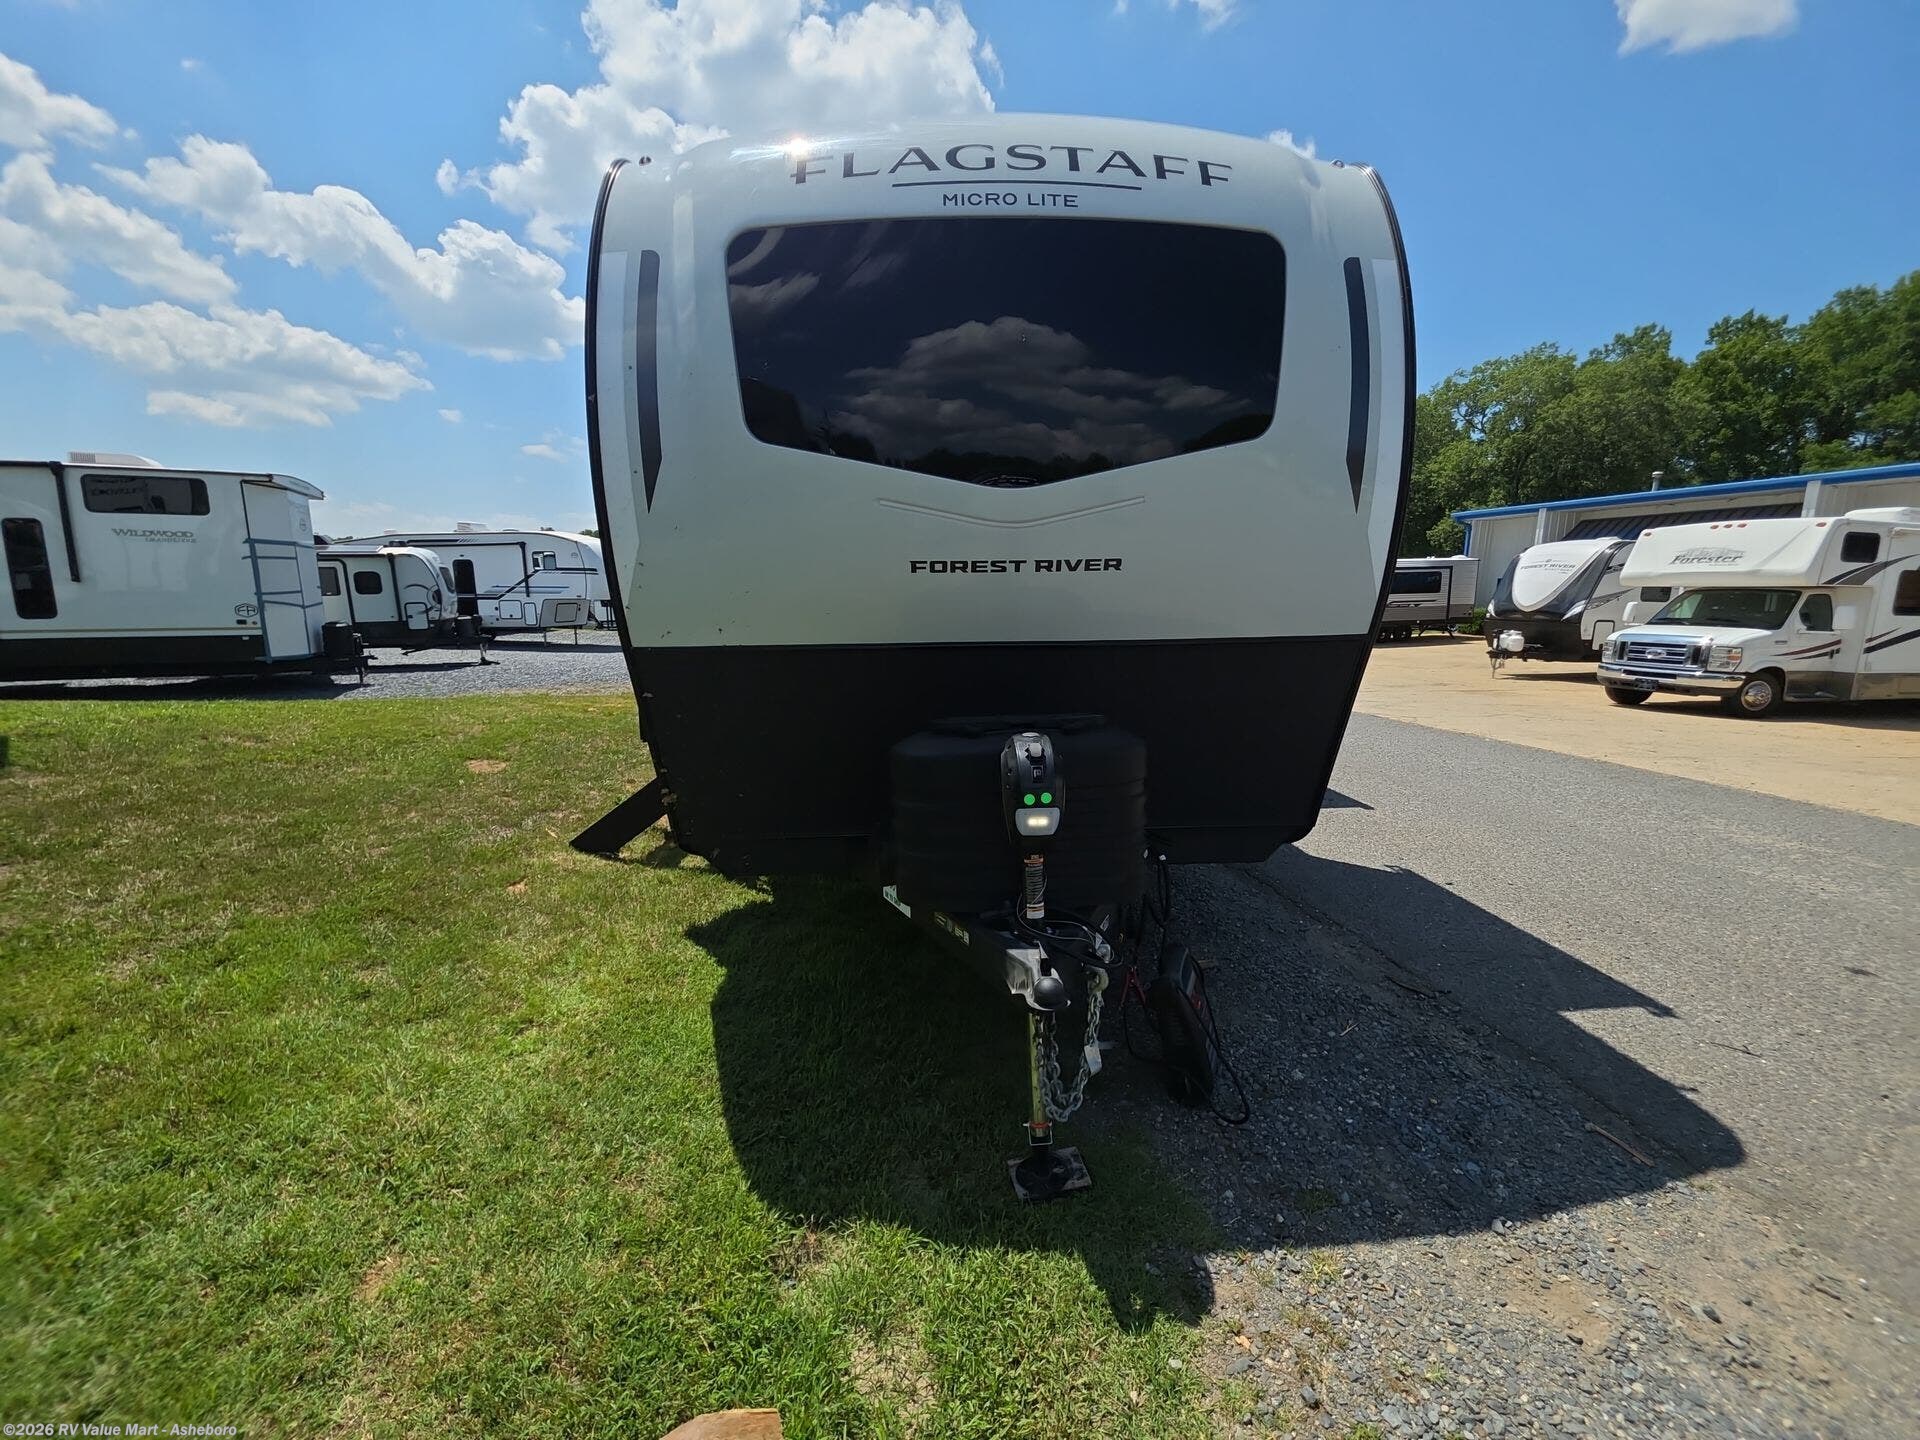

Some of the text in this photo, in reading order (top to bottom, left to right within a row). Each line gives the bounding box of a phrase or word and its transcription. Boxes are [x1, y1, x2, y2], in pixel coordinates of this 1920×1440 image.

[790, 143, 1234, 186] FLAGSTAFF
[942, 192, 1079, 208] MICRO LITE
[111, 528, 194, 538] WILDWOOD
[909, 558, 1122, 574] FOREST RIVER
[1668, 554, 1743, 565] Forester
